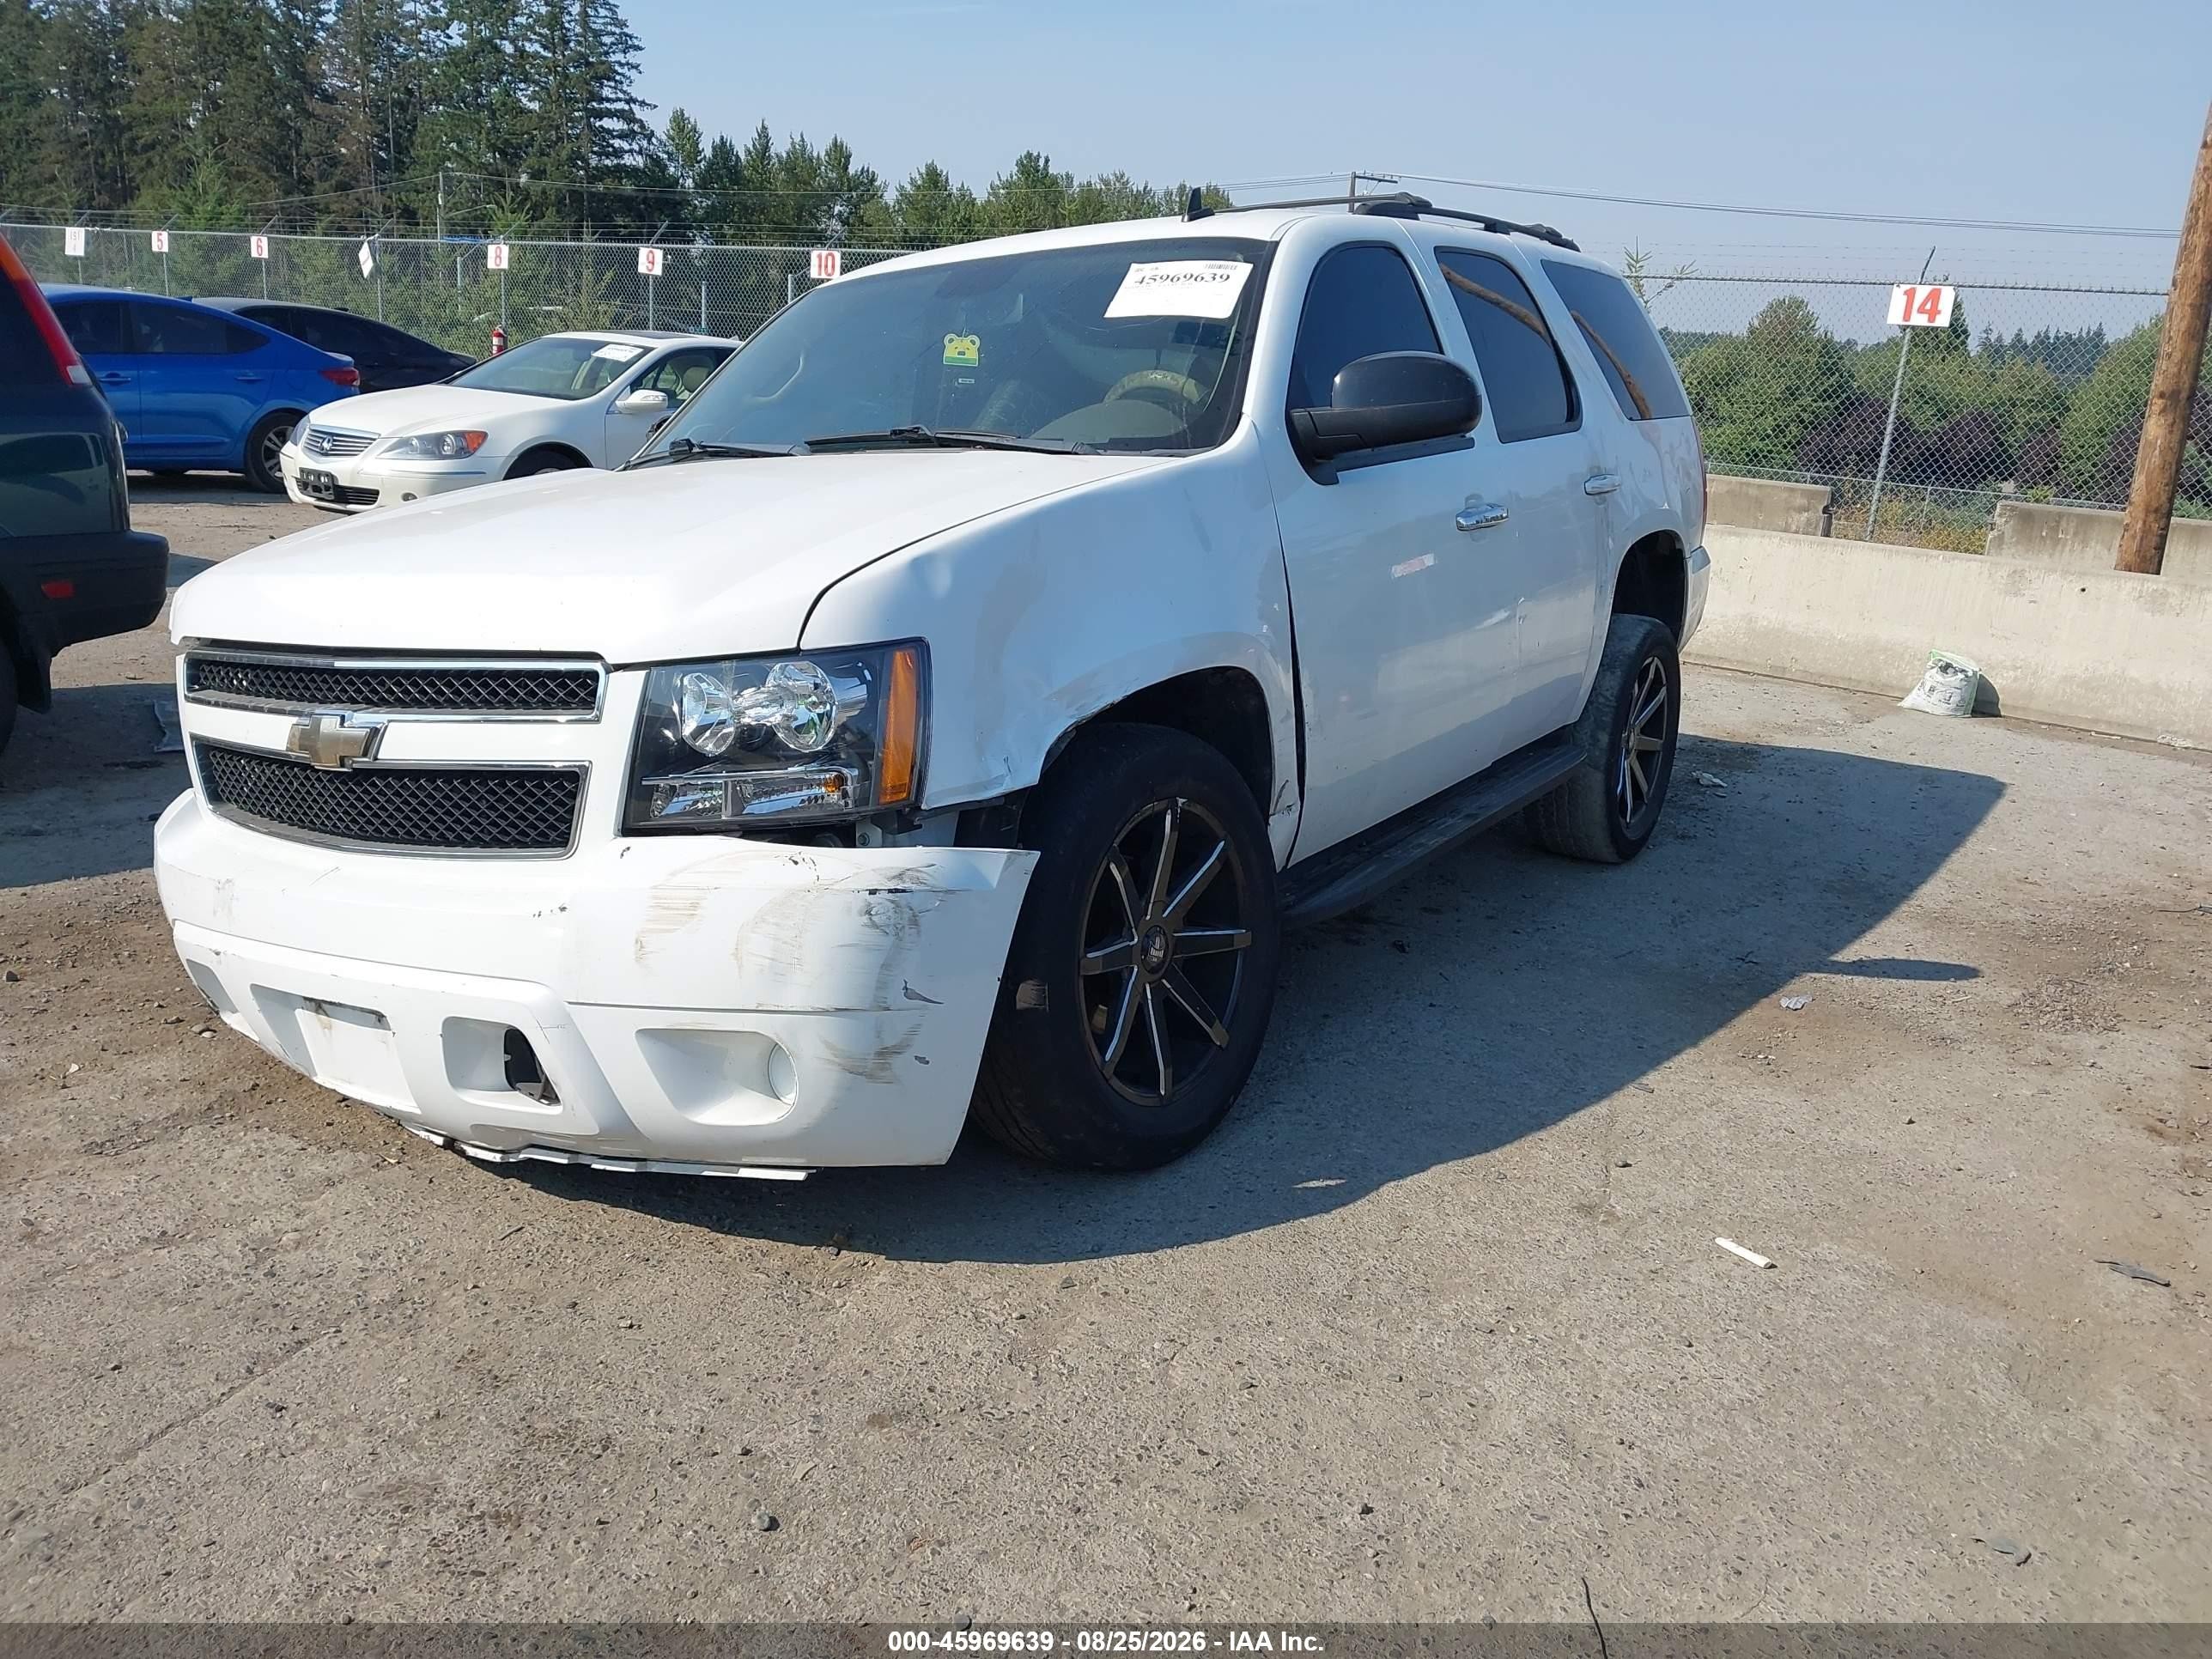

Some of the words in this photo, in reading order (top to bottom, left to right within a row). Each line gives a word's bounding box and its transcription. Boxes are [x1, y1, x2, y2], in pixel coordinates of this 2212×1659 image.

[156, 232, 163, 251] 5
[256, 237, 263, 257] 6
[494, 246, 502, 267] 8
[646, 249, 655, 273] 9
[816, 252, 836, 277] 10
[1133, 272, 1231, 286] 45969639
[1902, 286, 1942, 324] 14
